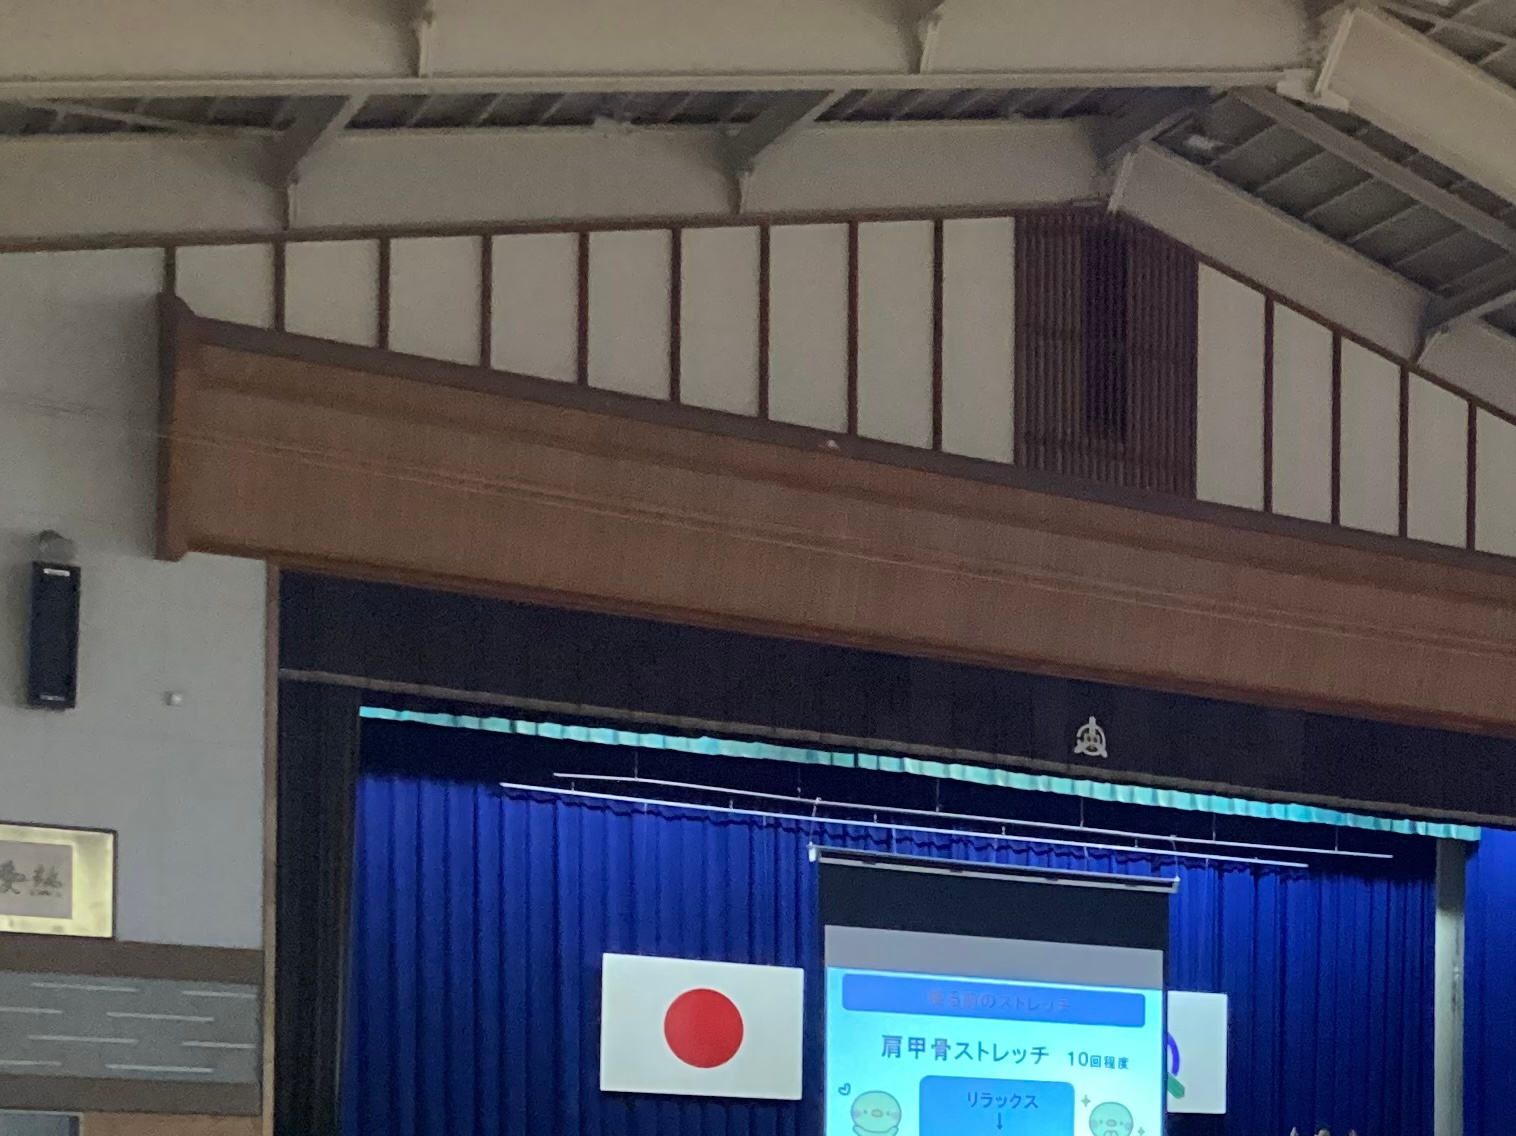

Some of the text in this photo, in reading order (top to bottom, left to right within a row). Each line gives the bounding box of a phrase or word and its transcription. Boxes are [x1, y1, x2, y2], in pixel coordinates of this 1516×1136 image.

[881, 1034, 1129, 1070] 肩甲骨ストレッチ 10回程度
[967, 1091, 1039, 1109] リラックス
